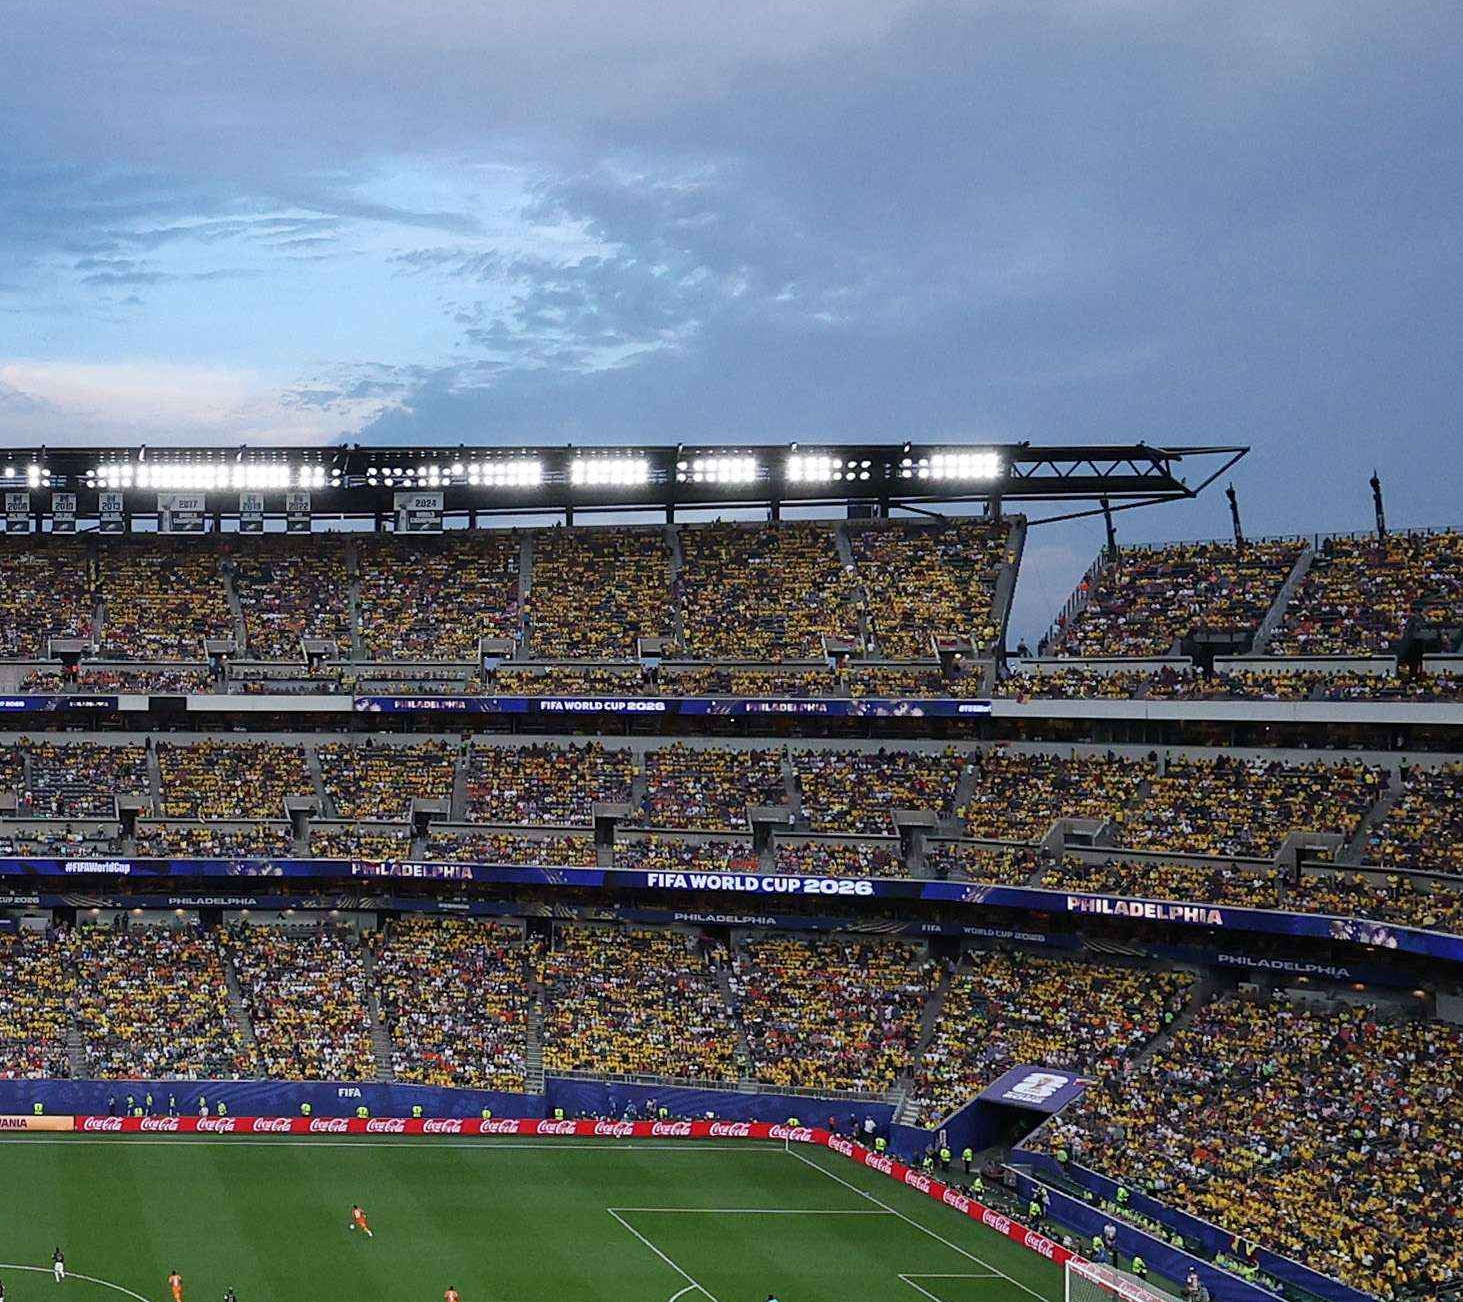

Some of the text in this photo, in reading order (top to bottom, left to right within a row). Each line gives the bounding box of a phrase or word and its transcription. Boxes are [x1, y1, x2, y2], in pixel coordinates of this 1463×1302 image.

[541, 701, 563, 710] FIFA
[565, 701, 603, 711] WORLD
[604, 702, 625, 711] CUP
[64, 861, 131, 875] #FIFAWorldCup
[352, 862, 473, 880] PHILADELPHIA
[647, 873, 874, 896] FIFA WORLD CUP 2026
[168, 897, 257, 905] PHILADELPHIA
[1067, 896, 1223, 925] PHILADELPHIA
[674, 912, 777, 925] PHILADELPHIA
[1218, 954, 1351, 977] PHILADELPHIA
[338, 1086, 362, 1097] FIFA
